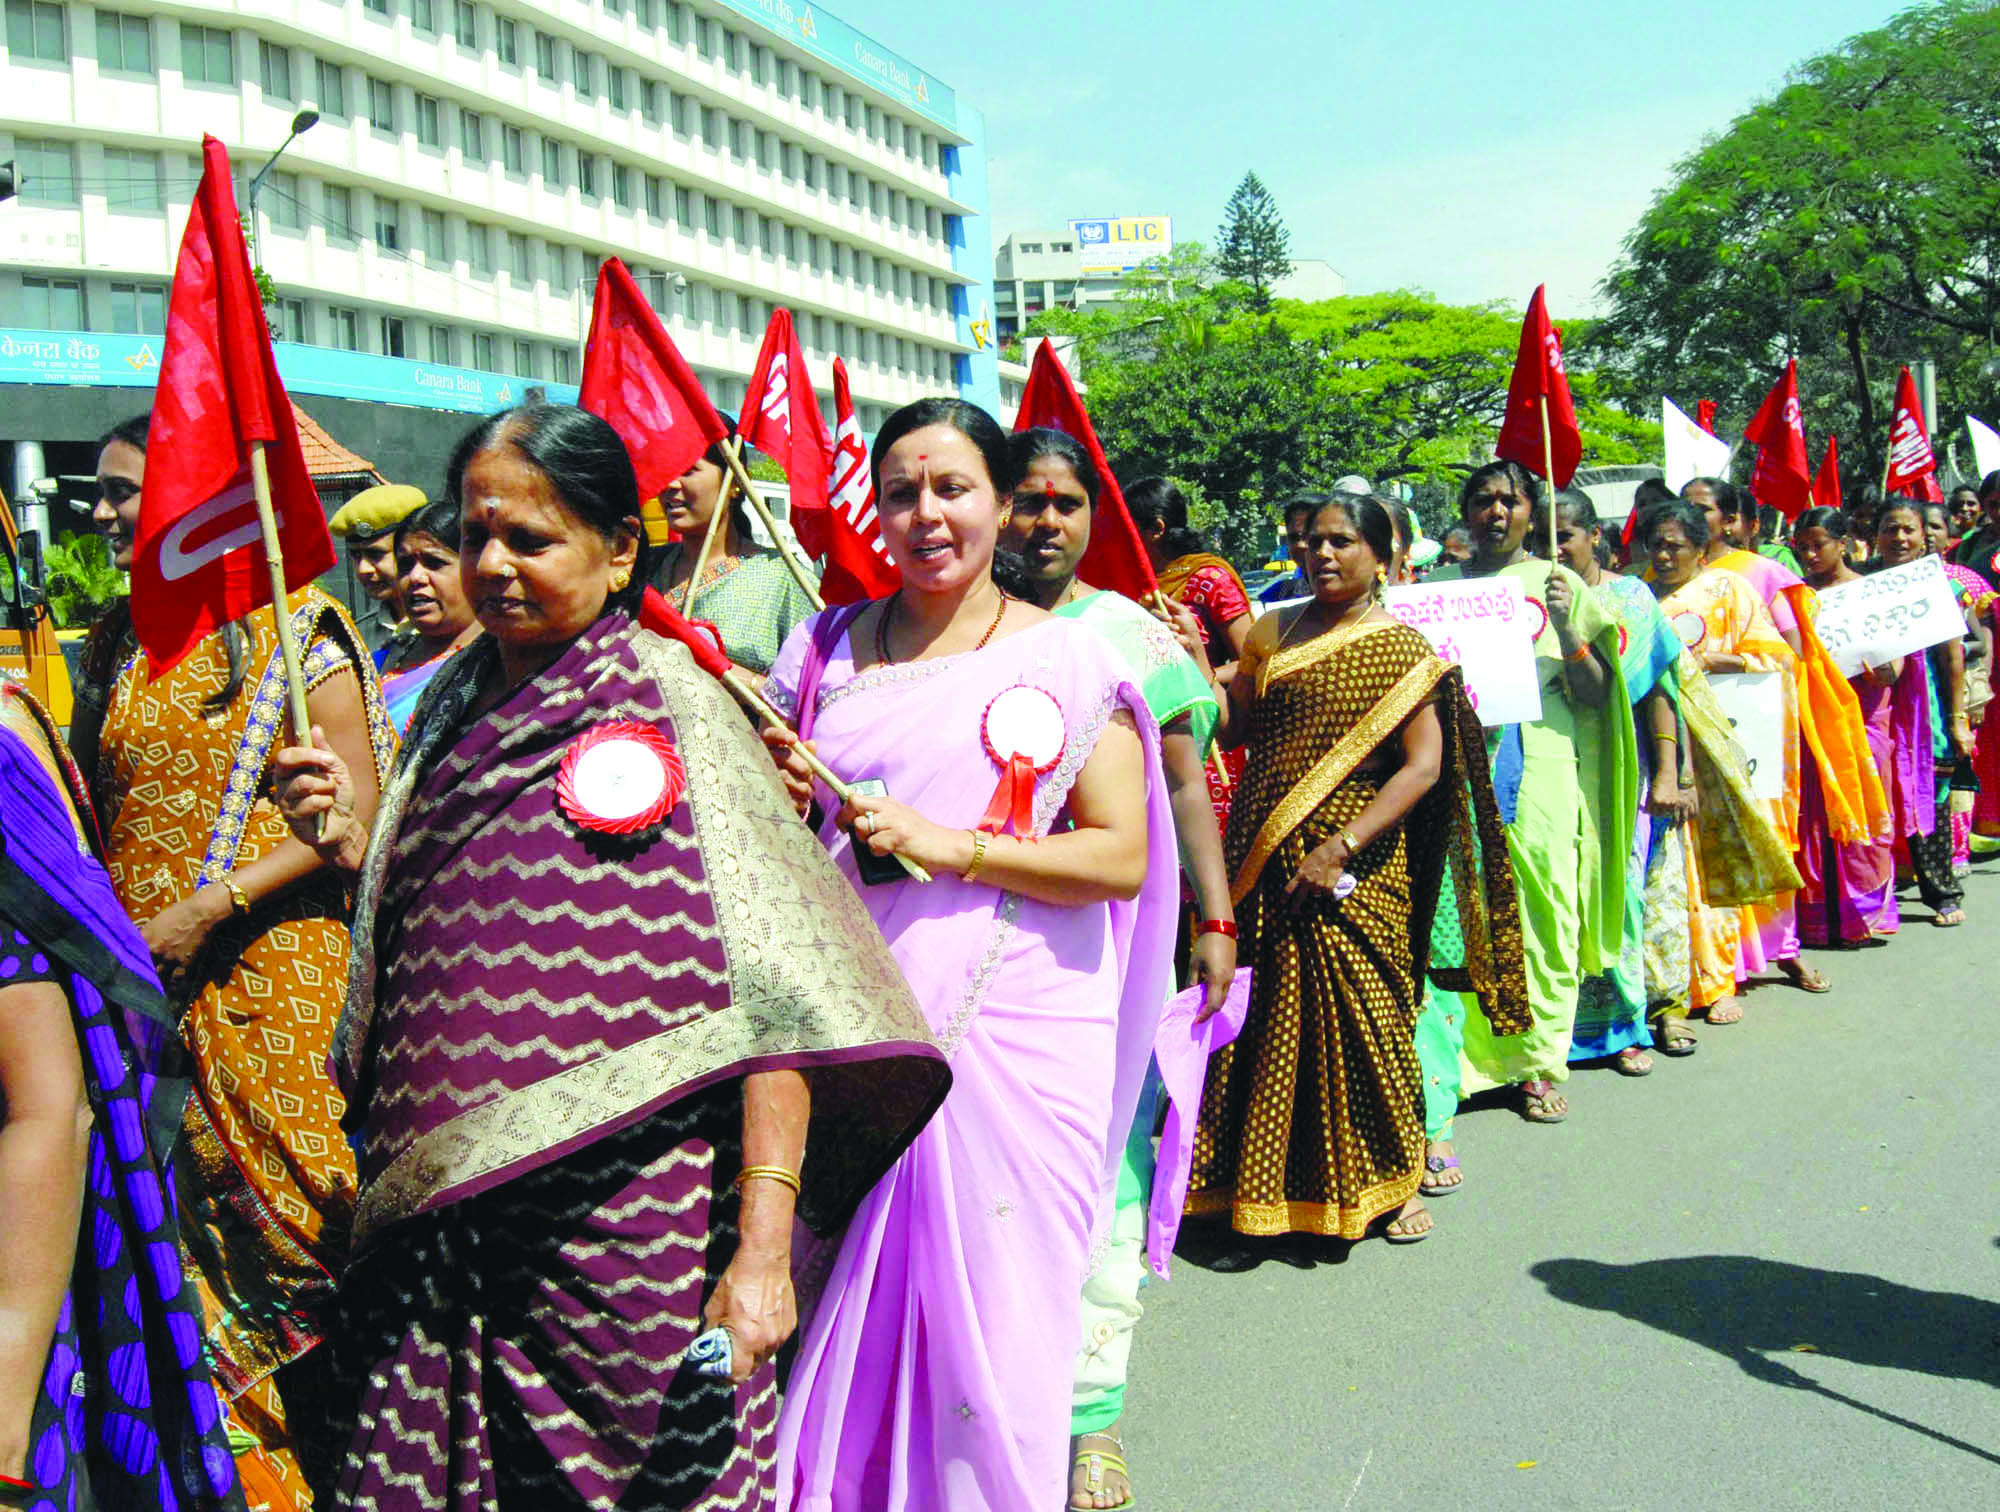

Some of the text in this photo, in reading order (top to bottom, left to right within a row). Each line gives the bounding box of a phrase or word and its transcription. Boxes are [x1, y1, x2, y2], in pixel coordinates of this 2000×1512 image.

[855, 41, 888, 78] Canara
[889, 61, 911, 89] Bank
[1117, 222, 1158, 241] LIC
[0, 335, 60, 360] केनरा
[415, 367, 482, 394] Canara Bank
